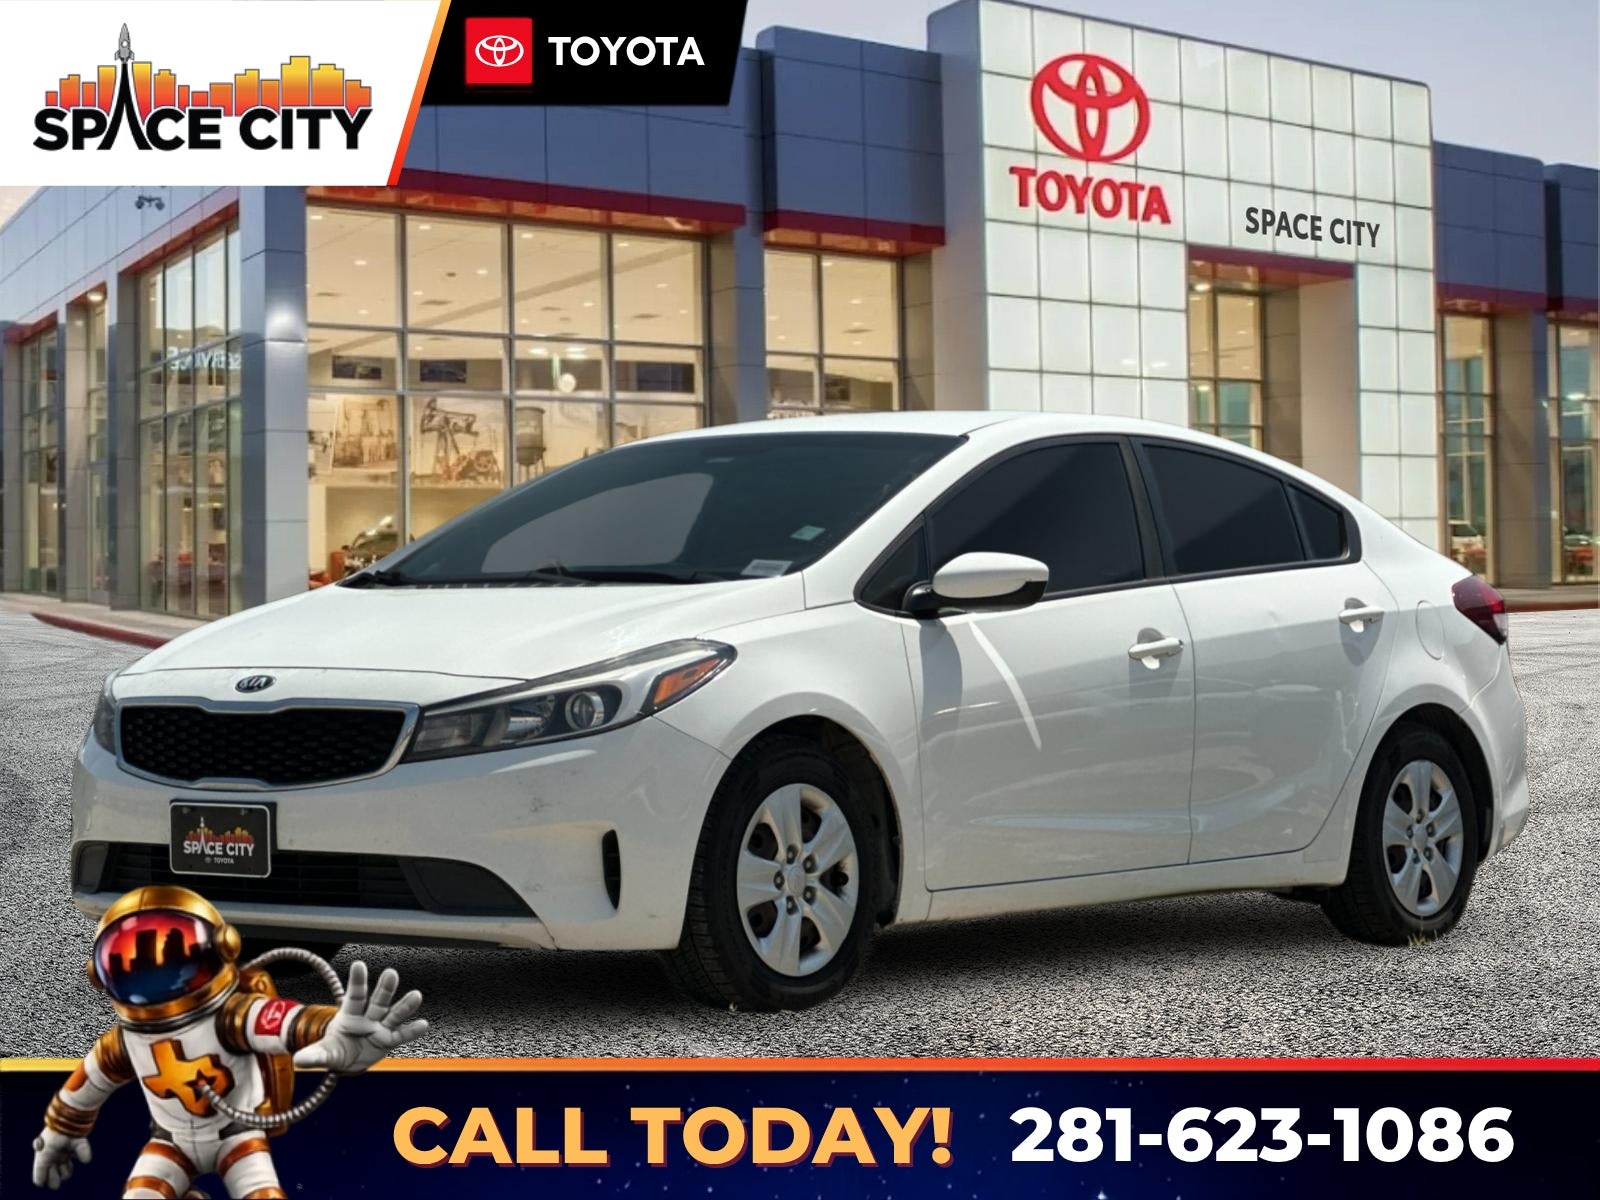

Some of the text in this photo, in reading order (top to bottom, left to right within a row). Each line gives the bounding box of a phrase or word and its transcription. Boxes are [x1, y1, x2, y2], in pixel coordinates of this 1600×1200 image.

[1009, 165, 1171, 225] TOYOTA
[1245, 206, 1380, 248] SPACE CITY
[183, 840, 255, 857] SPACE CITY
[213, 857, 235, 865] TOYOTA
